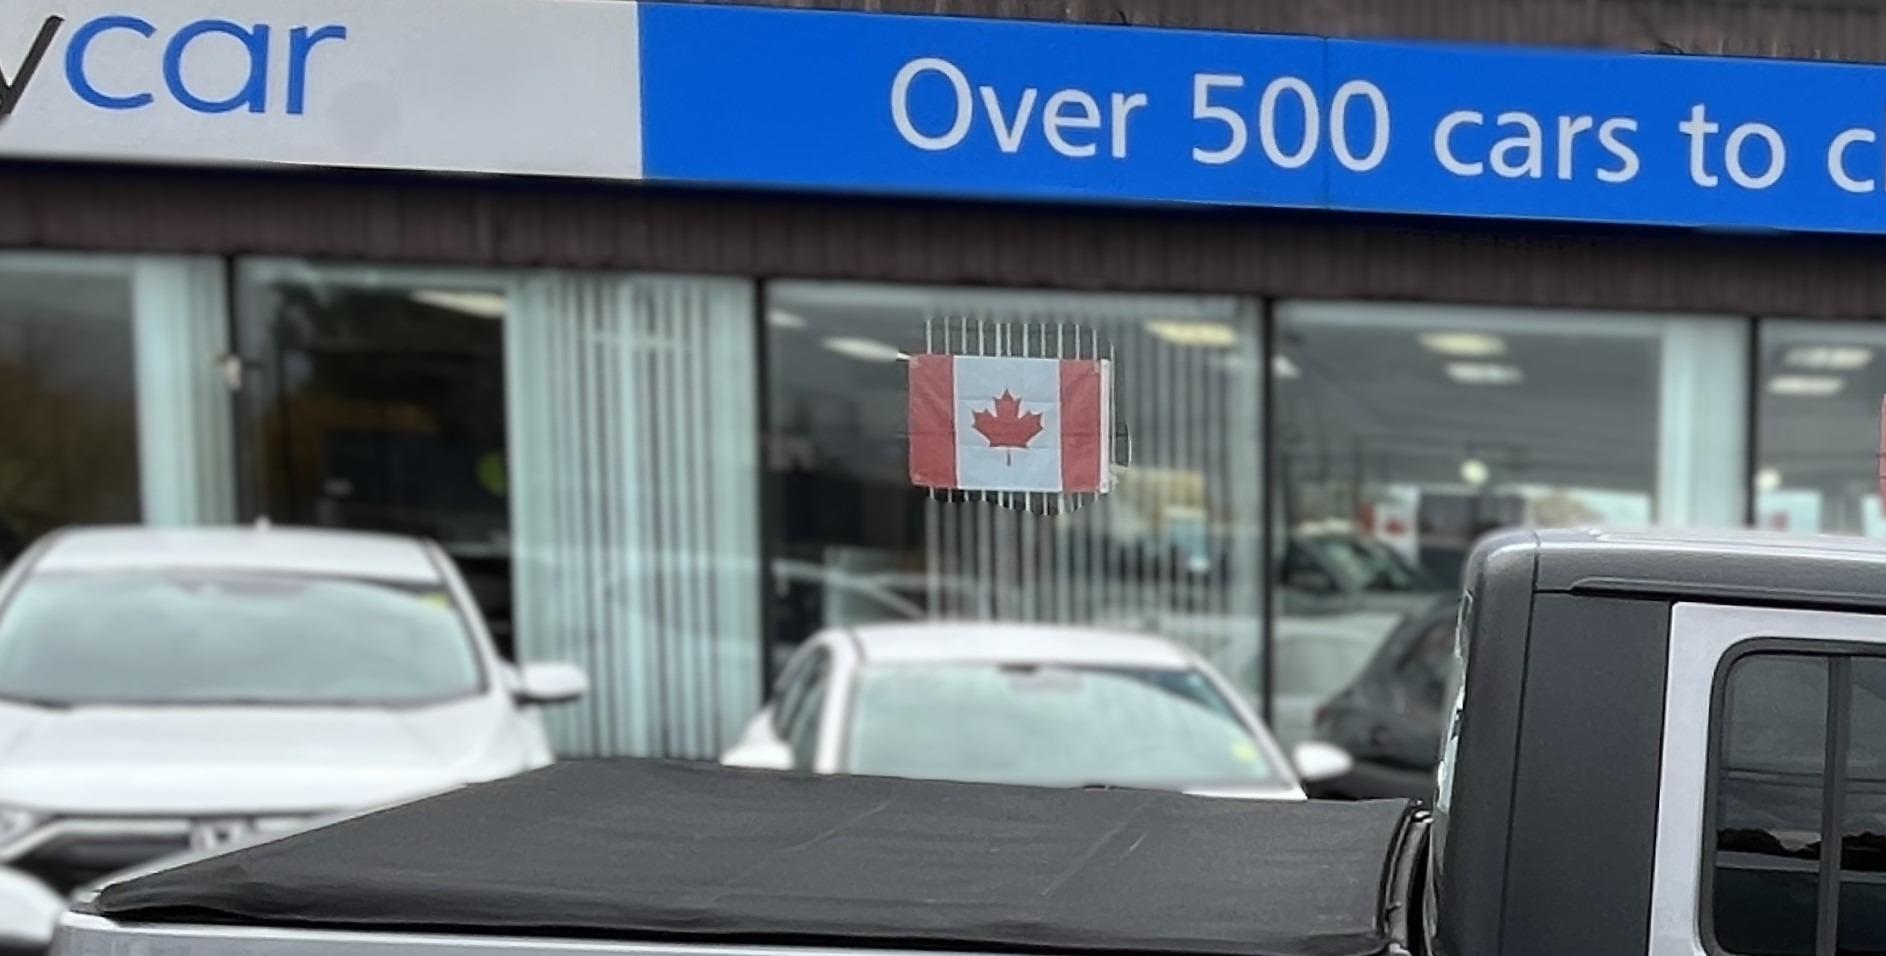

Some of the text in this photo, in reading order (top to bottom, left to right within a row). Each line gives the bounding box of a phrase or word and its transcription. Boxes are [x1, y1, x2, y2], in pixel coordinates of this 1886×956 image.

[890, 57, 1148, 159] Over
[1192, 72, 1391, 173] 500
[1433, 109, 1641, 184] cars
[1678, 103, 1787, 190] to
